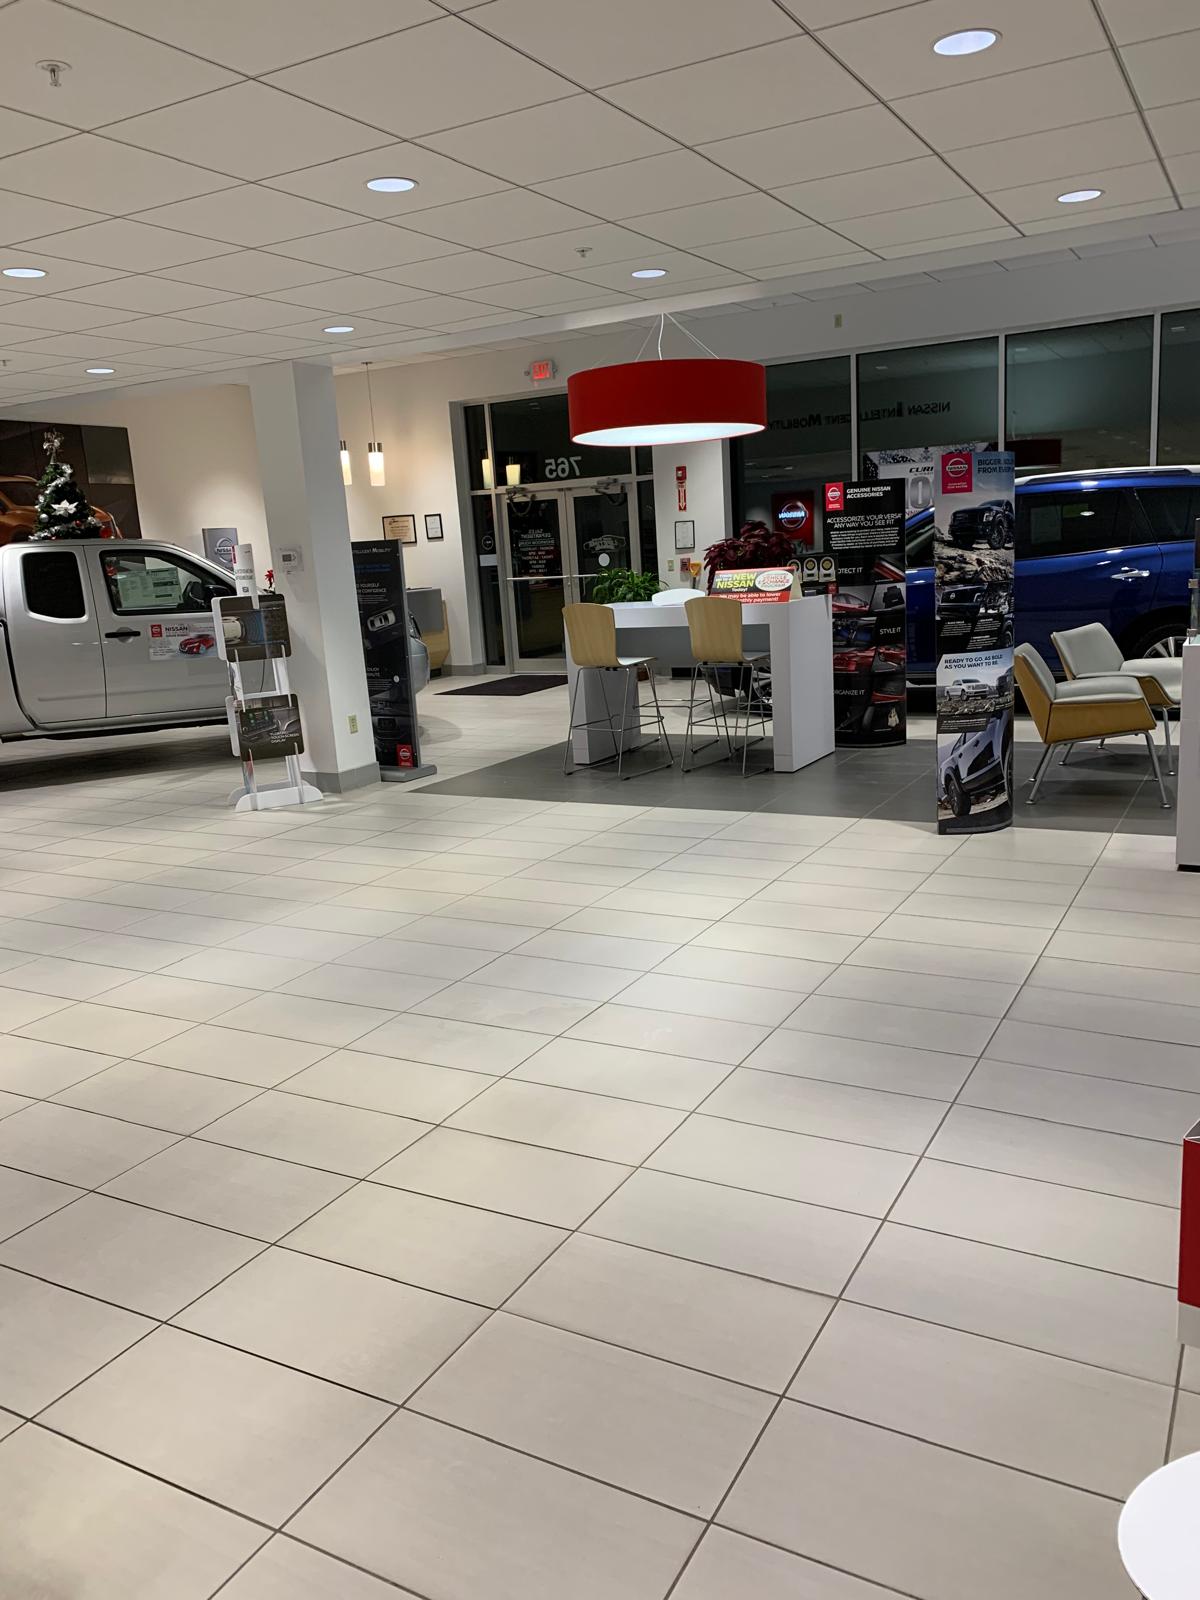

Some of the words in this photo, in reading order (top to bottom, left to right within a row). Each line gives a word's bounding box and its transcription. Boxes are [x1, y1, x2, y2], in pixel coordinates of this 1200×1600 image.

[827, 515, 865, 524] ACCESSORIZE
[733, 573, 757, 581] NEW
[717, 580, 754, 589] NISSAN
